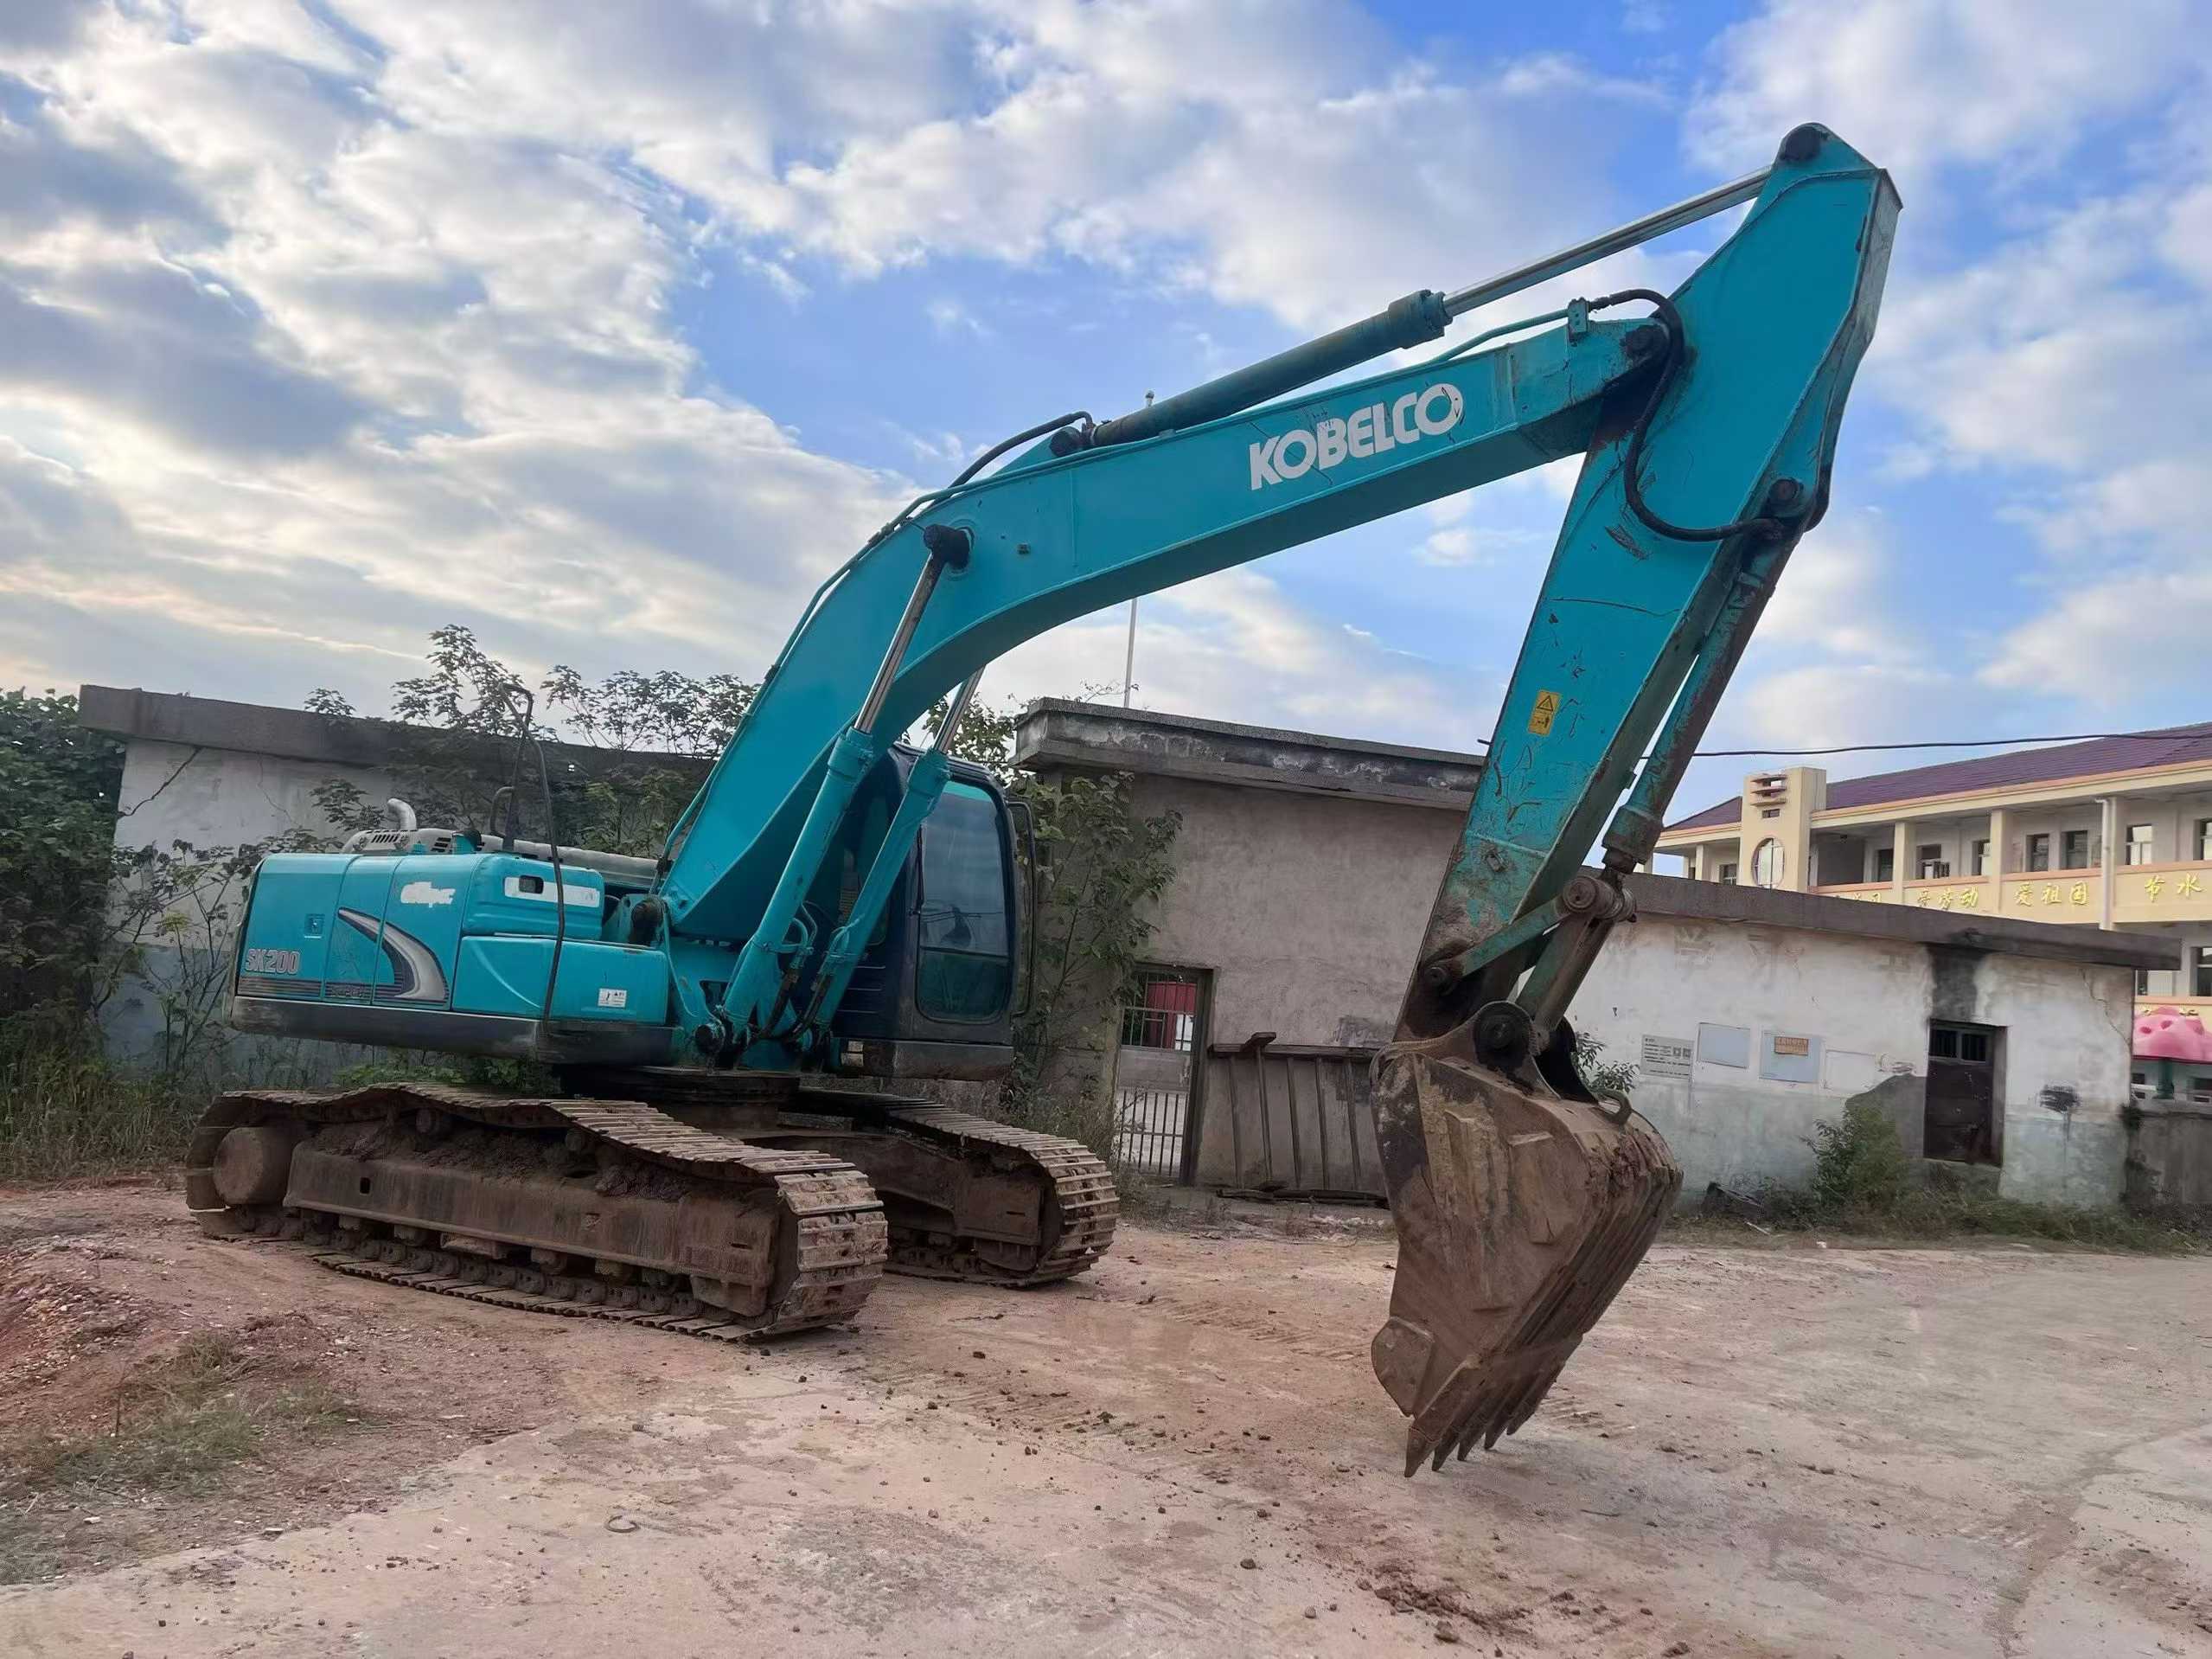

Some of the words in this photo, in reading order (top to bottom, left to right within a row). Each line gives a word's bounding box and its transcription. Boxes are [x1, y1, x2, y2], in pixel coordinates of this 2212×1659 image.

[1249, 382, 1464, 491] KOBELCO
[2013, 880, 2089, 906] 爱祖国
[245, 948, 300, 975] SK200
